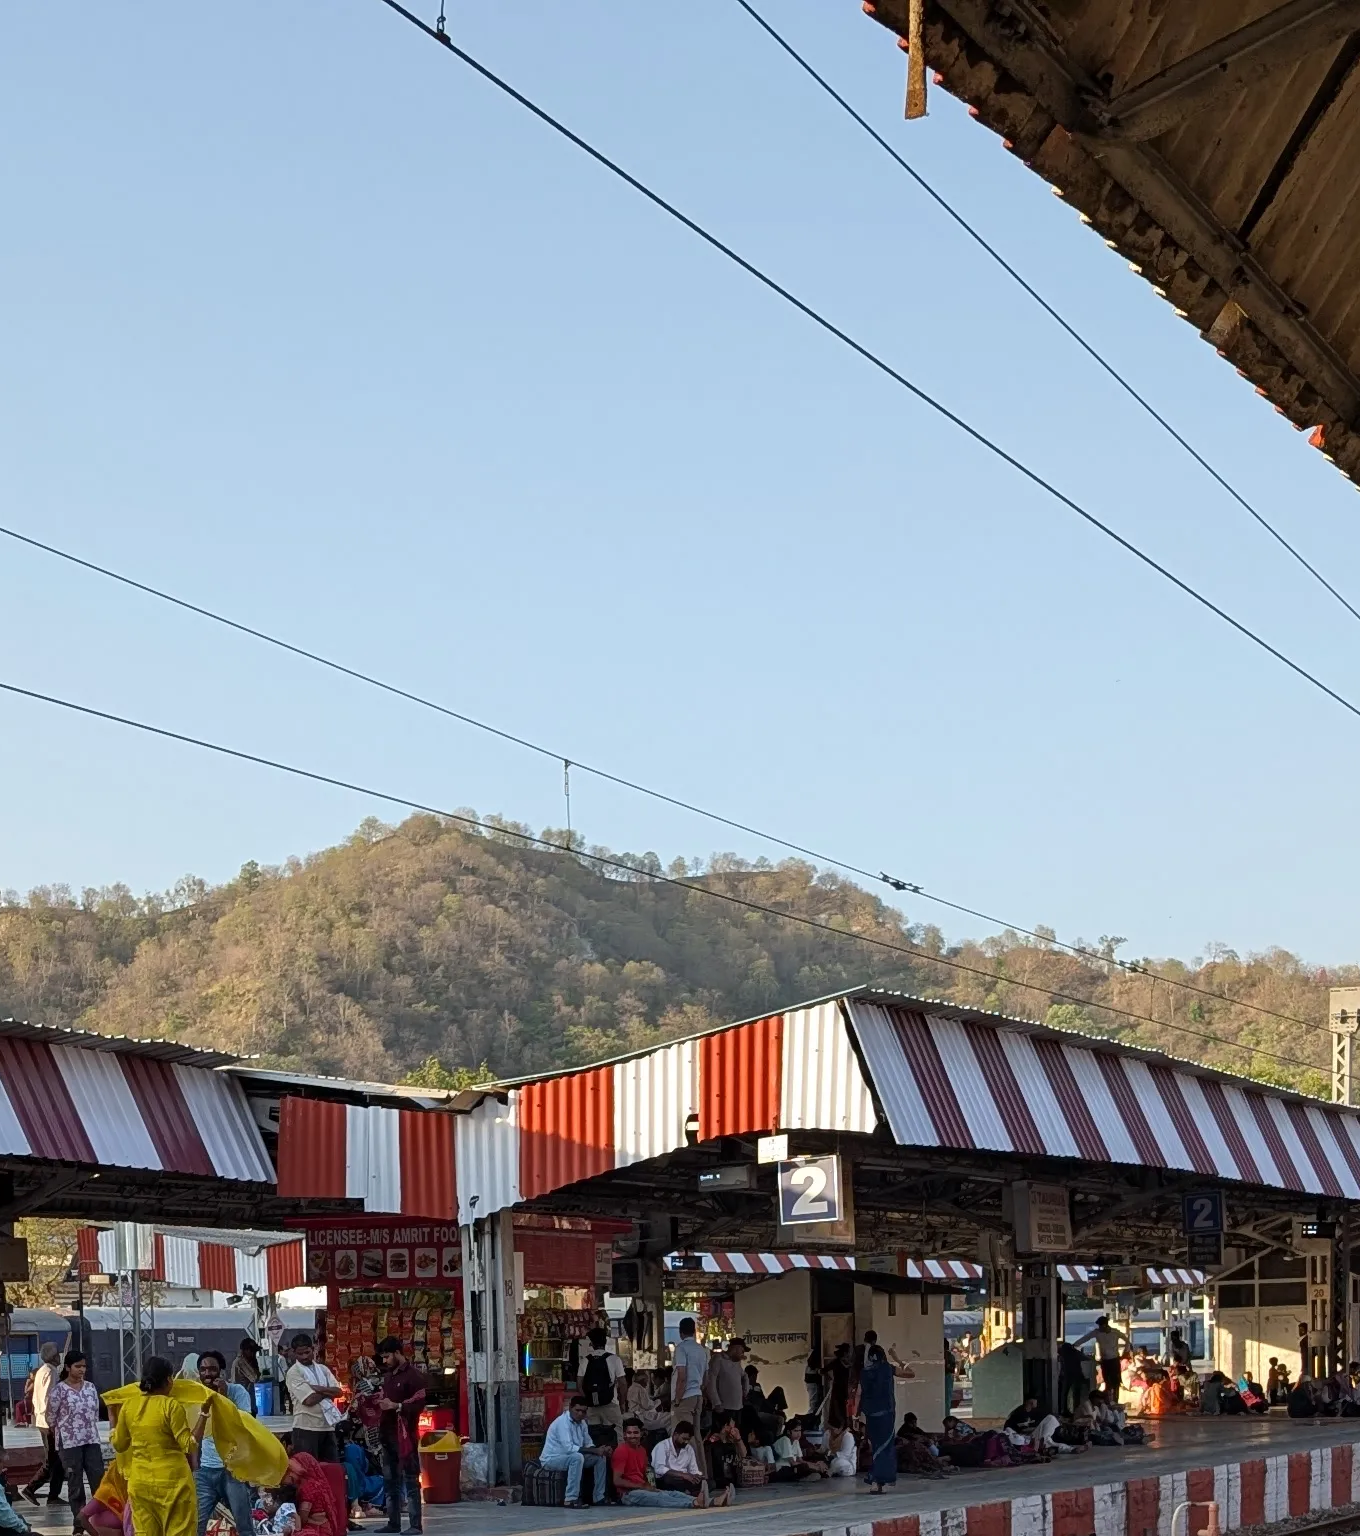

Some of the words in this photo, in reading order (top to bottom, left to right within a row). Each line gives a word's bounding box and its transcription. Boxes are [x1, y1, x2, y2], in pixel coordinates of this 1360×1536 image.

[791, 1166, 828, 1216] 2
[1193, 1198, 1214, 1228] 2
[393, 1227, 430, 1243] AMRIT
[434, 1226, 462, 1243] FOO
[504, 1280, 514, 1297] 18
[1030, 1284, 1041, 1296] 19
[1313, 1289, 1325, 1298] 20
